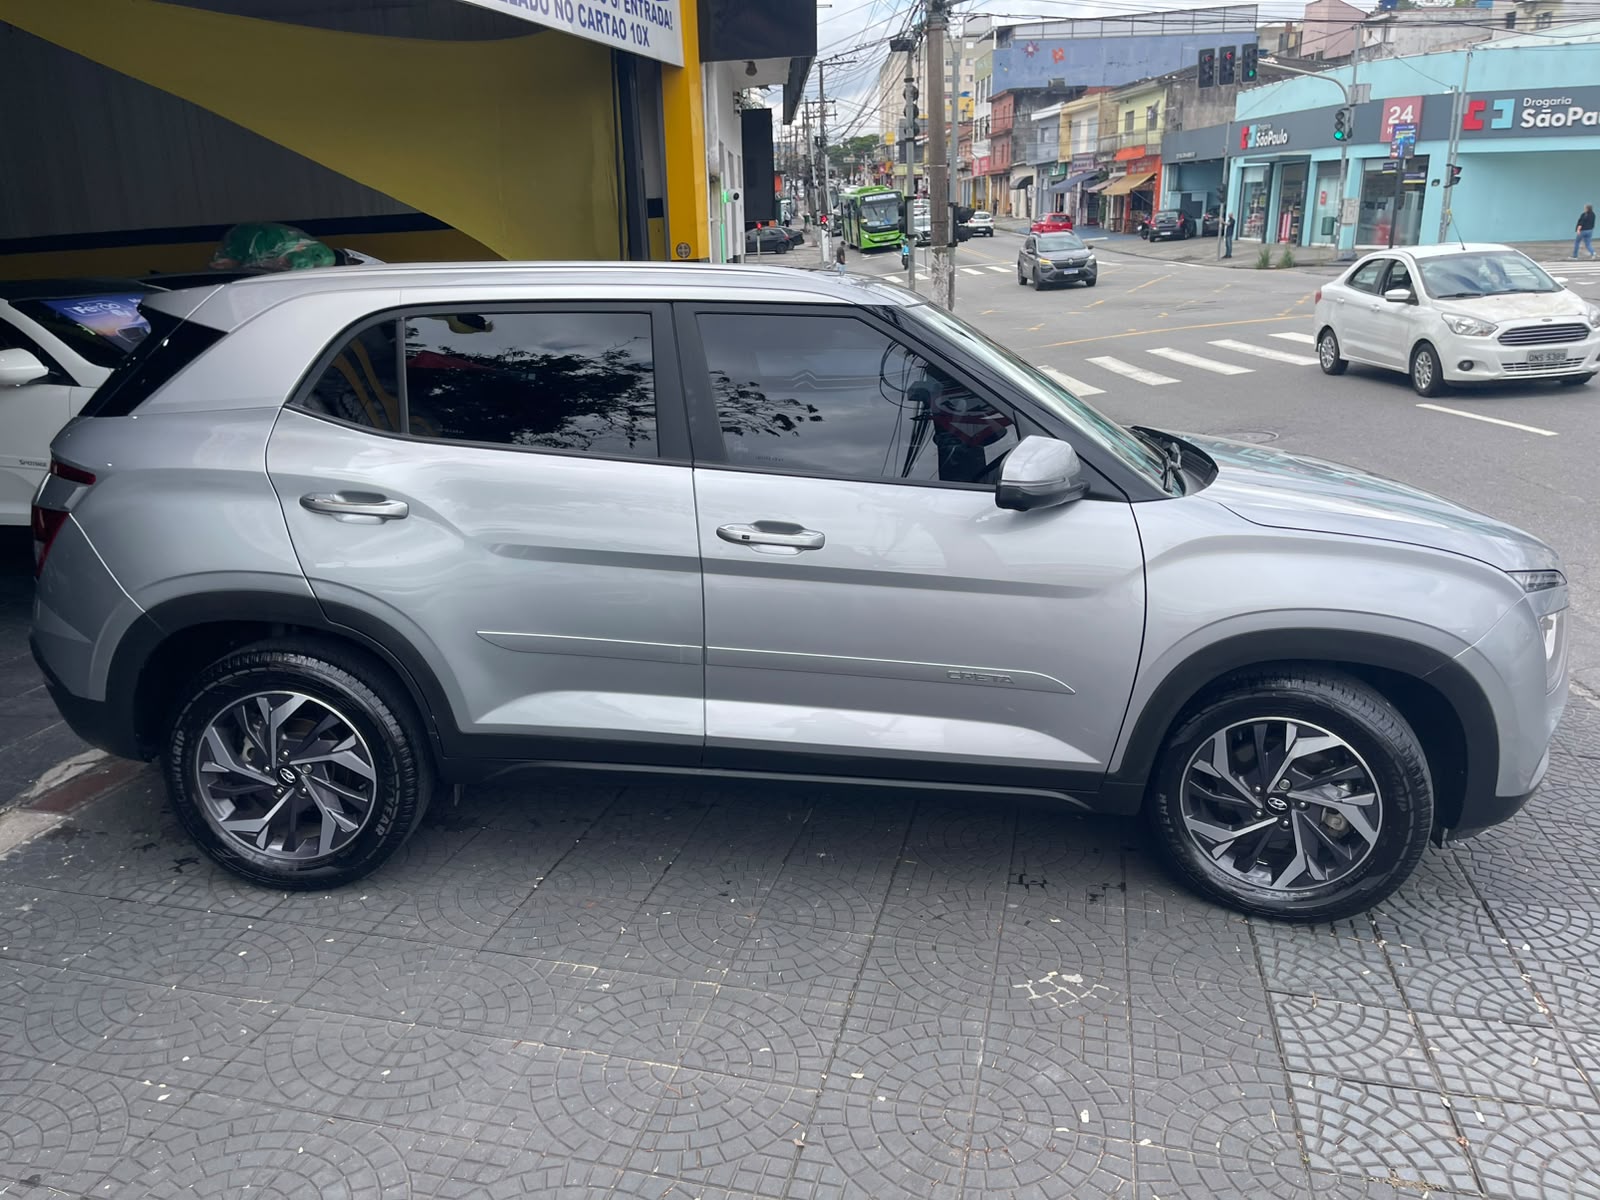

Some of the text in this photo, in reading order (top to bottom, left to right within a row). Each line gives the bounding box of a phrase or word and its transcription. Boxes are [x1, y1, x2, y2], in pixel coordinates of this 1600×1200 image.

[554, 0, 574, 24] NO
[578, 3, 627, 41] CARTAO
[630, 22, 650, 47] 10X
[1523, 96, 1572, 108] Drogaria
[1388, 104, 1414, 125] 24
[1520, 106, 1600, 128] SãoPa
[945, 670, 1015, 685] CRETA
